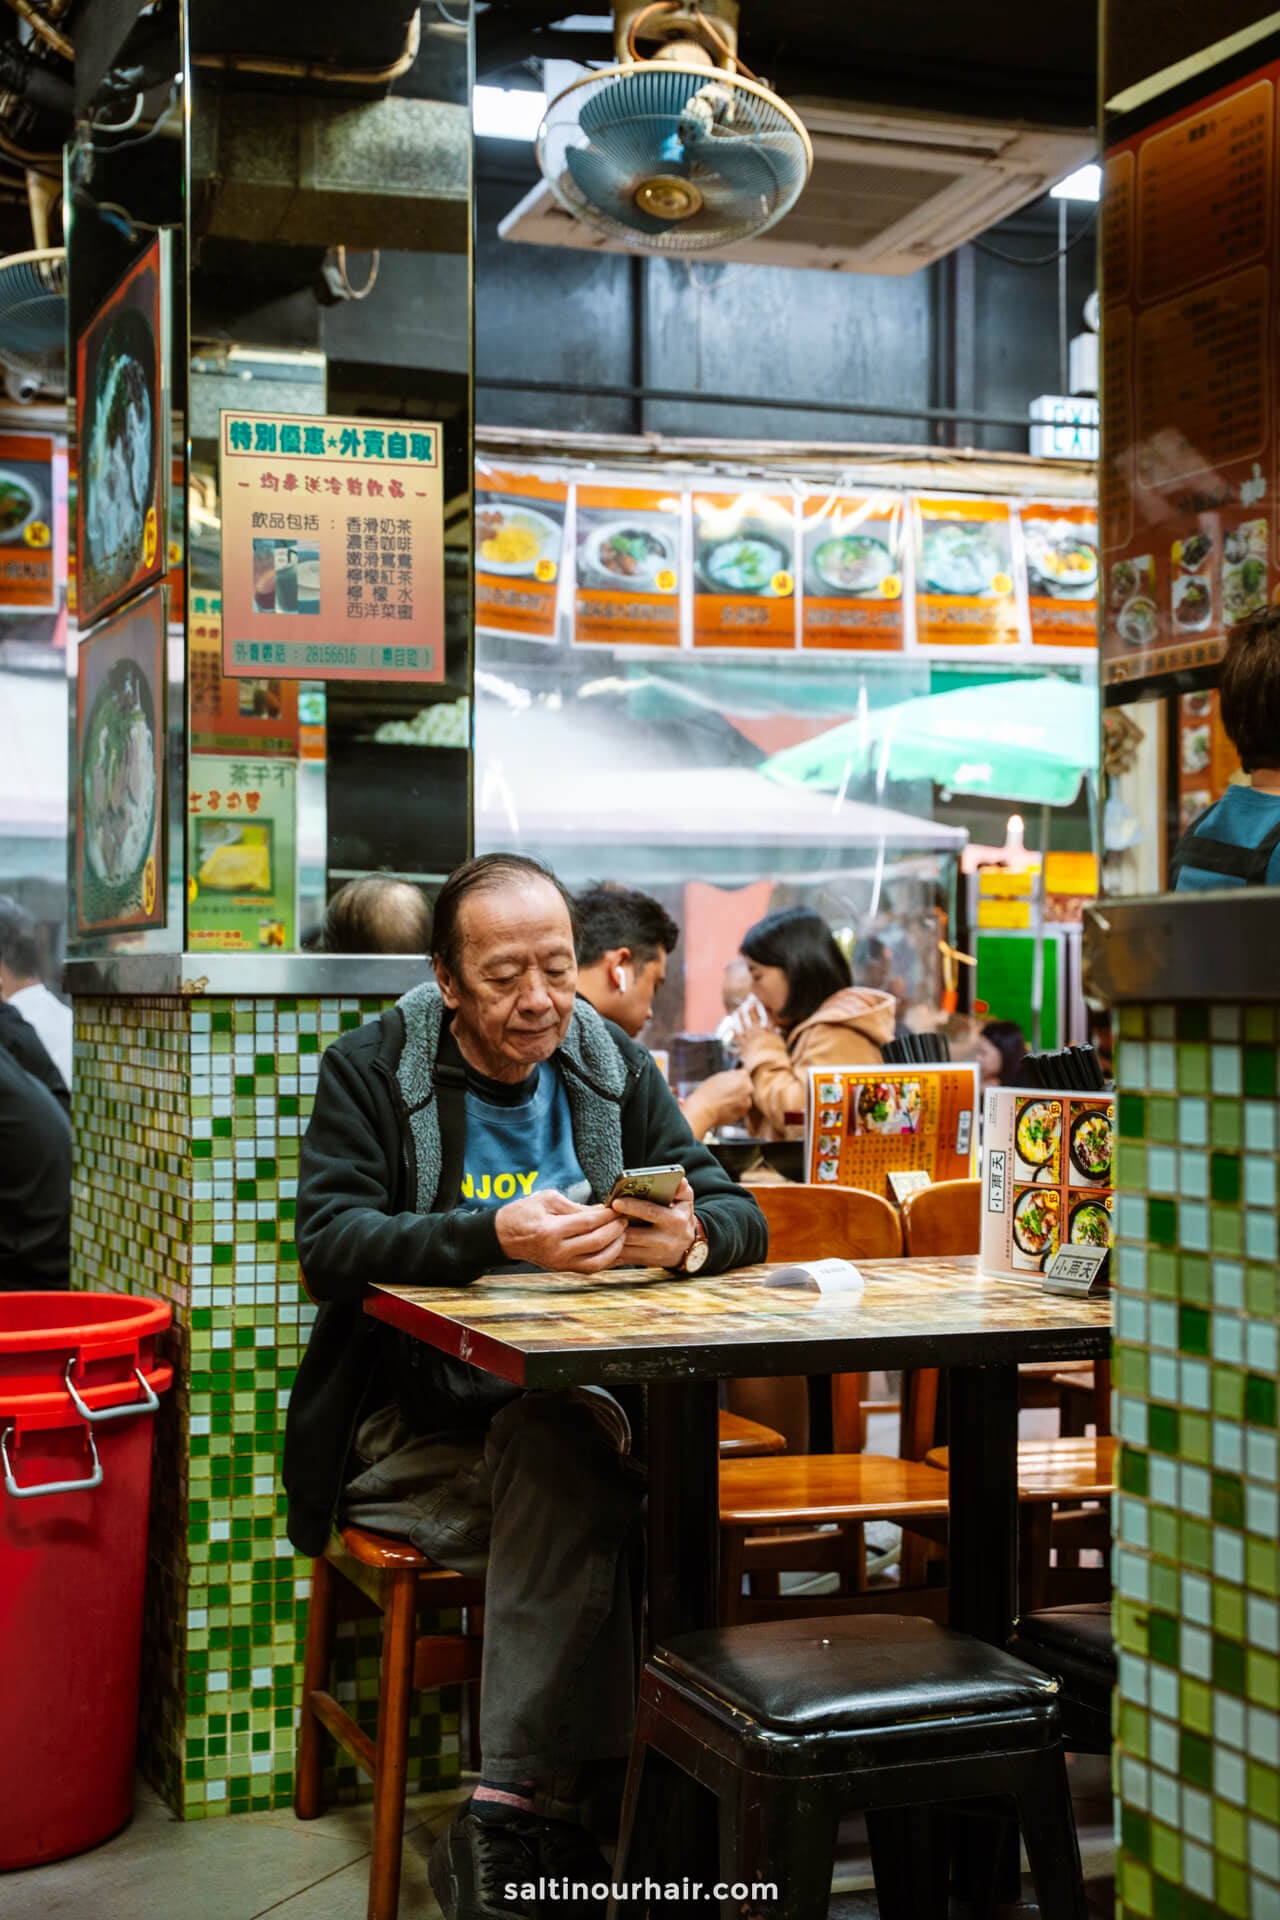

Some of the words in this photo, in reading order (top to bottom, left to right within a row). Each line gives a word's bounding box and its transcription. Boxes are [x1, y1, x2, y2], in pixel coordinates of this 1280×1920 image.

[230, 420, 325, 456] 特別優惠
[340, 427, 433, 463] 外賣自取
[346, 516, 412, 535] 香滑奶茶
[346, 534, 412, 552] 濃香咖啡
